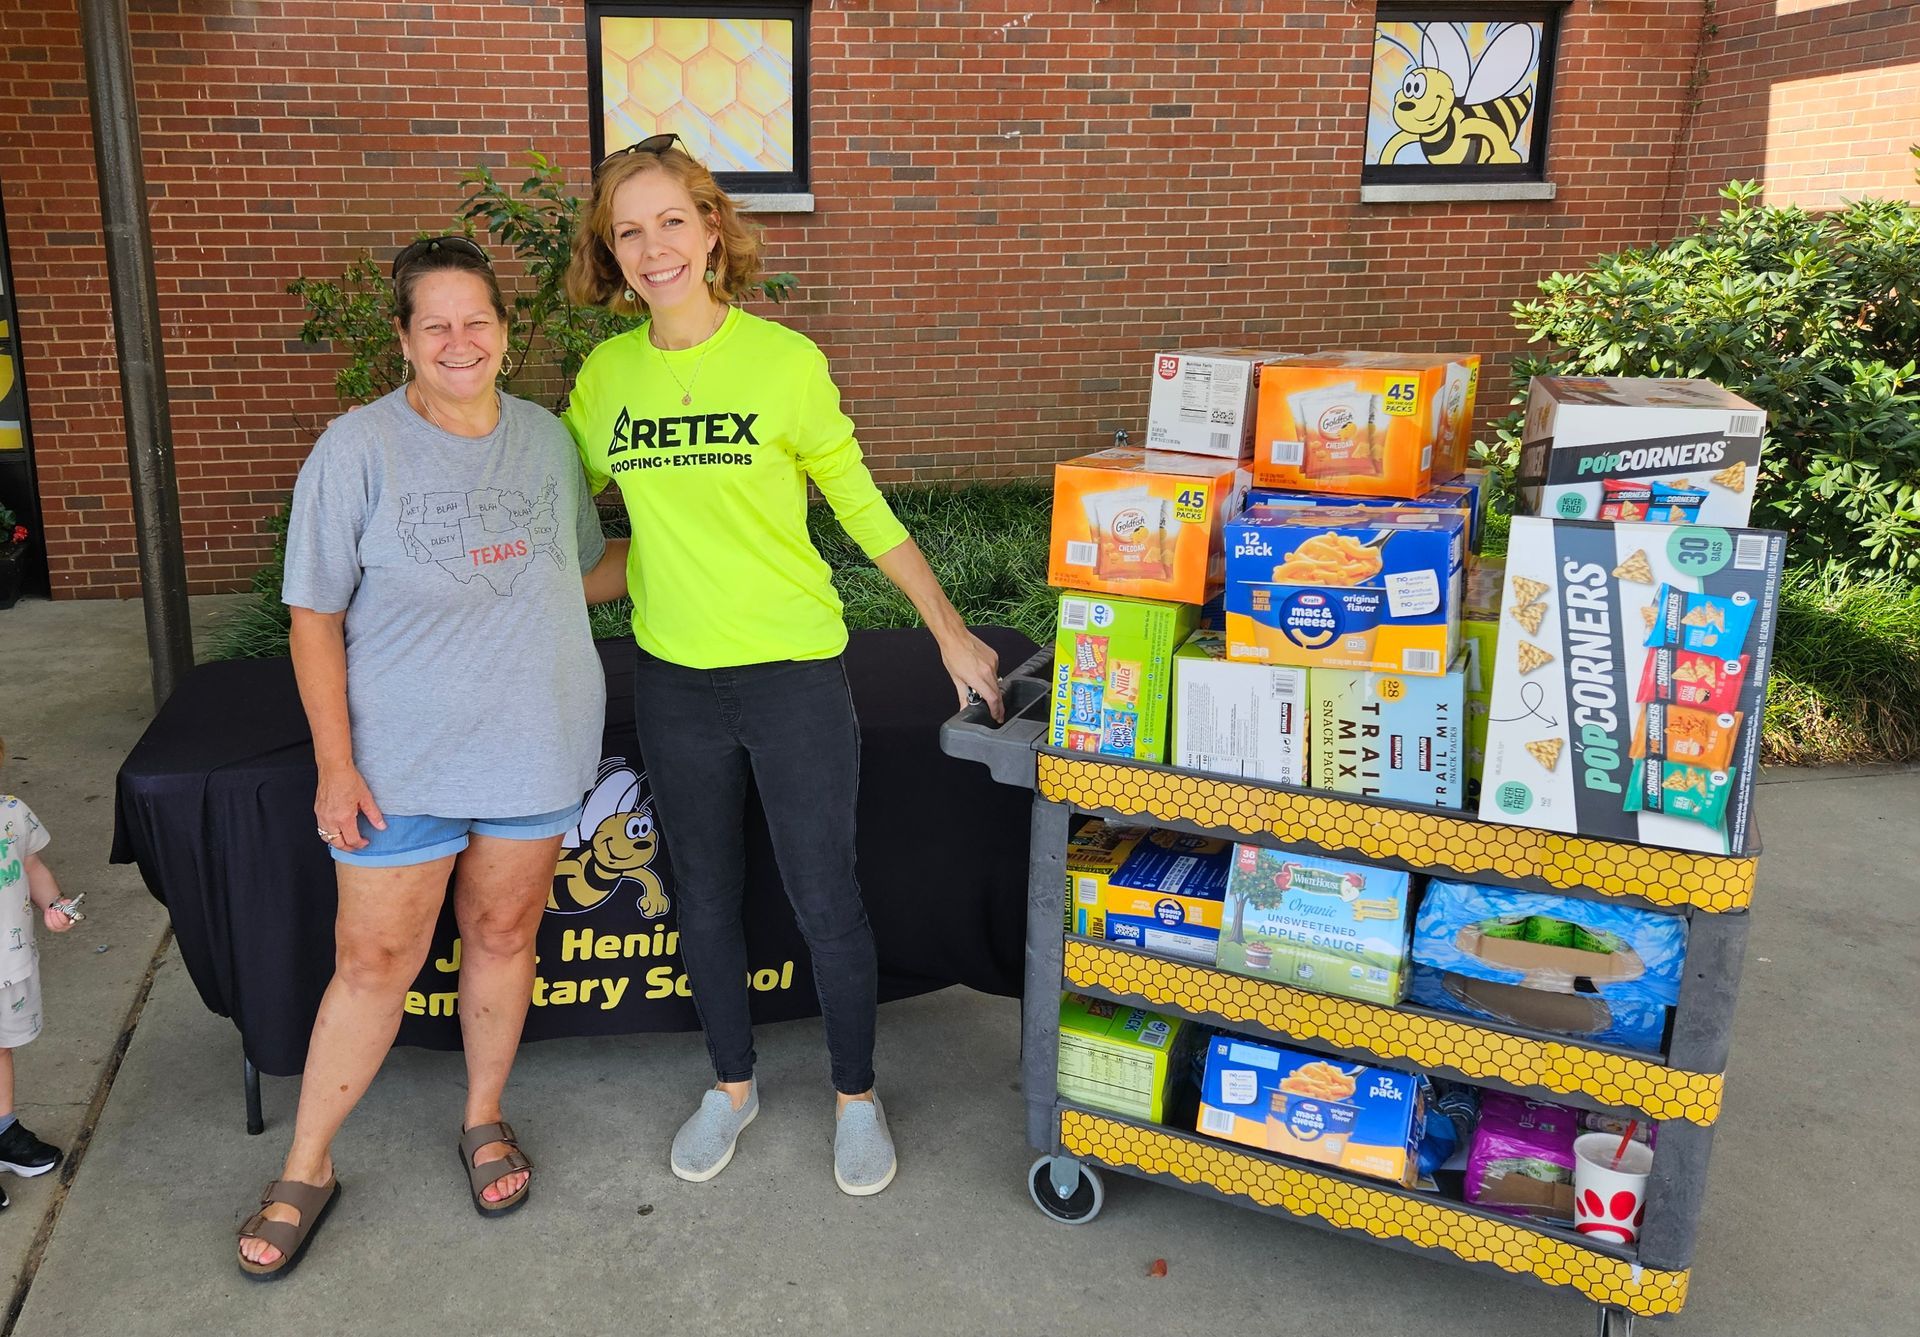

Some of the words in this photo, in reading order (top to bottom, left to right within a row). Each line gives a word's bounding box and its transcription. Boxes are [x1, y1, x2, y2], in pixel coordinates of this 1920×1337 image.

[1161, 359, 1175, 370] 30
[1388, 384, 1415, 400] 45
[1322, 412, 1354, 430] Goldfish
[1325, 441, 1354, 449] CHEDDAR
[1578, 440, 1726, 475] POPCORNERS
[437, 502, 458, 515] BLAH
[479, 503, 498, 512] BLAH
[1178, 491, 1205, 508] 45
[1561, 505, 1582, 514] FRIED
[1562, 498, 1582, 506] NEVER
[407, 506, 421, 516] WET
[513, 507, 532, 518] BLAH
[1176, 512, 1202, 520] PACKS
[1116, 517, 1145, 533] Goldfish
[431, 534, 456, 546] DUSTY
[1119, 544, 1145, 552] CHEDDAR
[1242, 532, 1260, 545] 12
[469, 539, 528, 567] TEXAS
[1235, 543, 1273, 558] pack
[1679, 538, 1710, 565] 30
[1711, 541, 1723, 562] BAGS
[1342, 595, 1379, 606] original
[1347, 603, 1377, 613] flavor
[1094, 605, 1105, 624] 40
[1077, 644, 1090, 671] Nutter
[1084, 642, 1098, 668] Butter
[1563, 561, 1623, 794] POPCORNERS
[1728, 663, 1738, 671] 10
[1058, 664, 1069, 698] PACK
[1116, 668, 1131, 696] Nilla
[1388, 681, 1400, 698] 28
[1076, 687, 1088, 721] OREO
[1085, 692, 1094, 713] mini
[1054, 702, 1066, 747] ARIETY
[1281, 703, 1289, 733] KIRKLAND
[1323, 700, 1334, 745] SNACK
[1436, 703, 1448, 738] MIX
[1111, 727, 1125, 748] Chips
[1450, 726, 1458, 754] PACKS
[1339, 719, 1357, 778] MIX
[1361, 702, 1380, 796] TRAIL
[1394, 736, 1402, 769] KIRKLAND
[1419, 737, 1427, 770] KIRKLAND
[1436, 751, 1447, 807] TRAIL
[1503, 787, 1514, 808] NEVER
[1513, 788, 1526, 810] FRIED
[1289, 898, 1337, 919] Organic
[1268, 913, 1357, 937] UNSWEETENED
[1258, 925, 1307, 943] APPLE
[1312, 933, 1365, 954] SAUCE
[645, 961, 794, 1000] Scol
[1124, 1008, 1147, 1033] PACK
[1369, 1086, 1403, 1101] pack
[1378, 1077, 1393, 1090] 12
[1330, 1108, 1354, 1117] original
